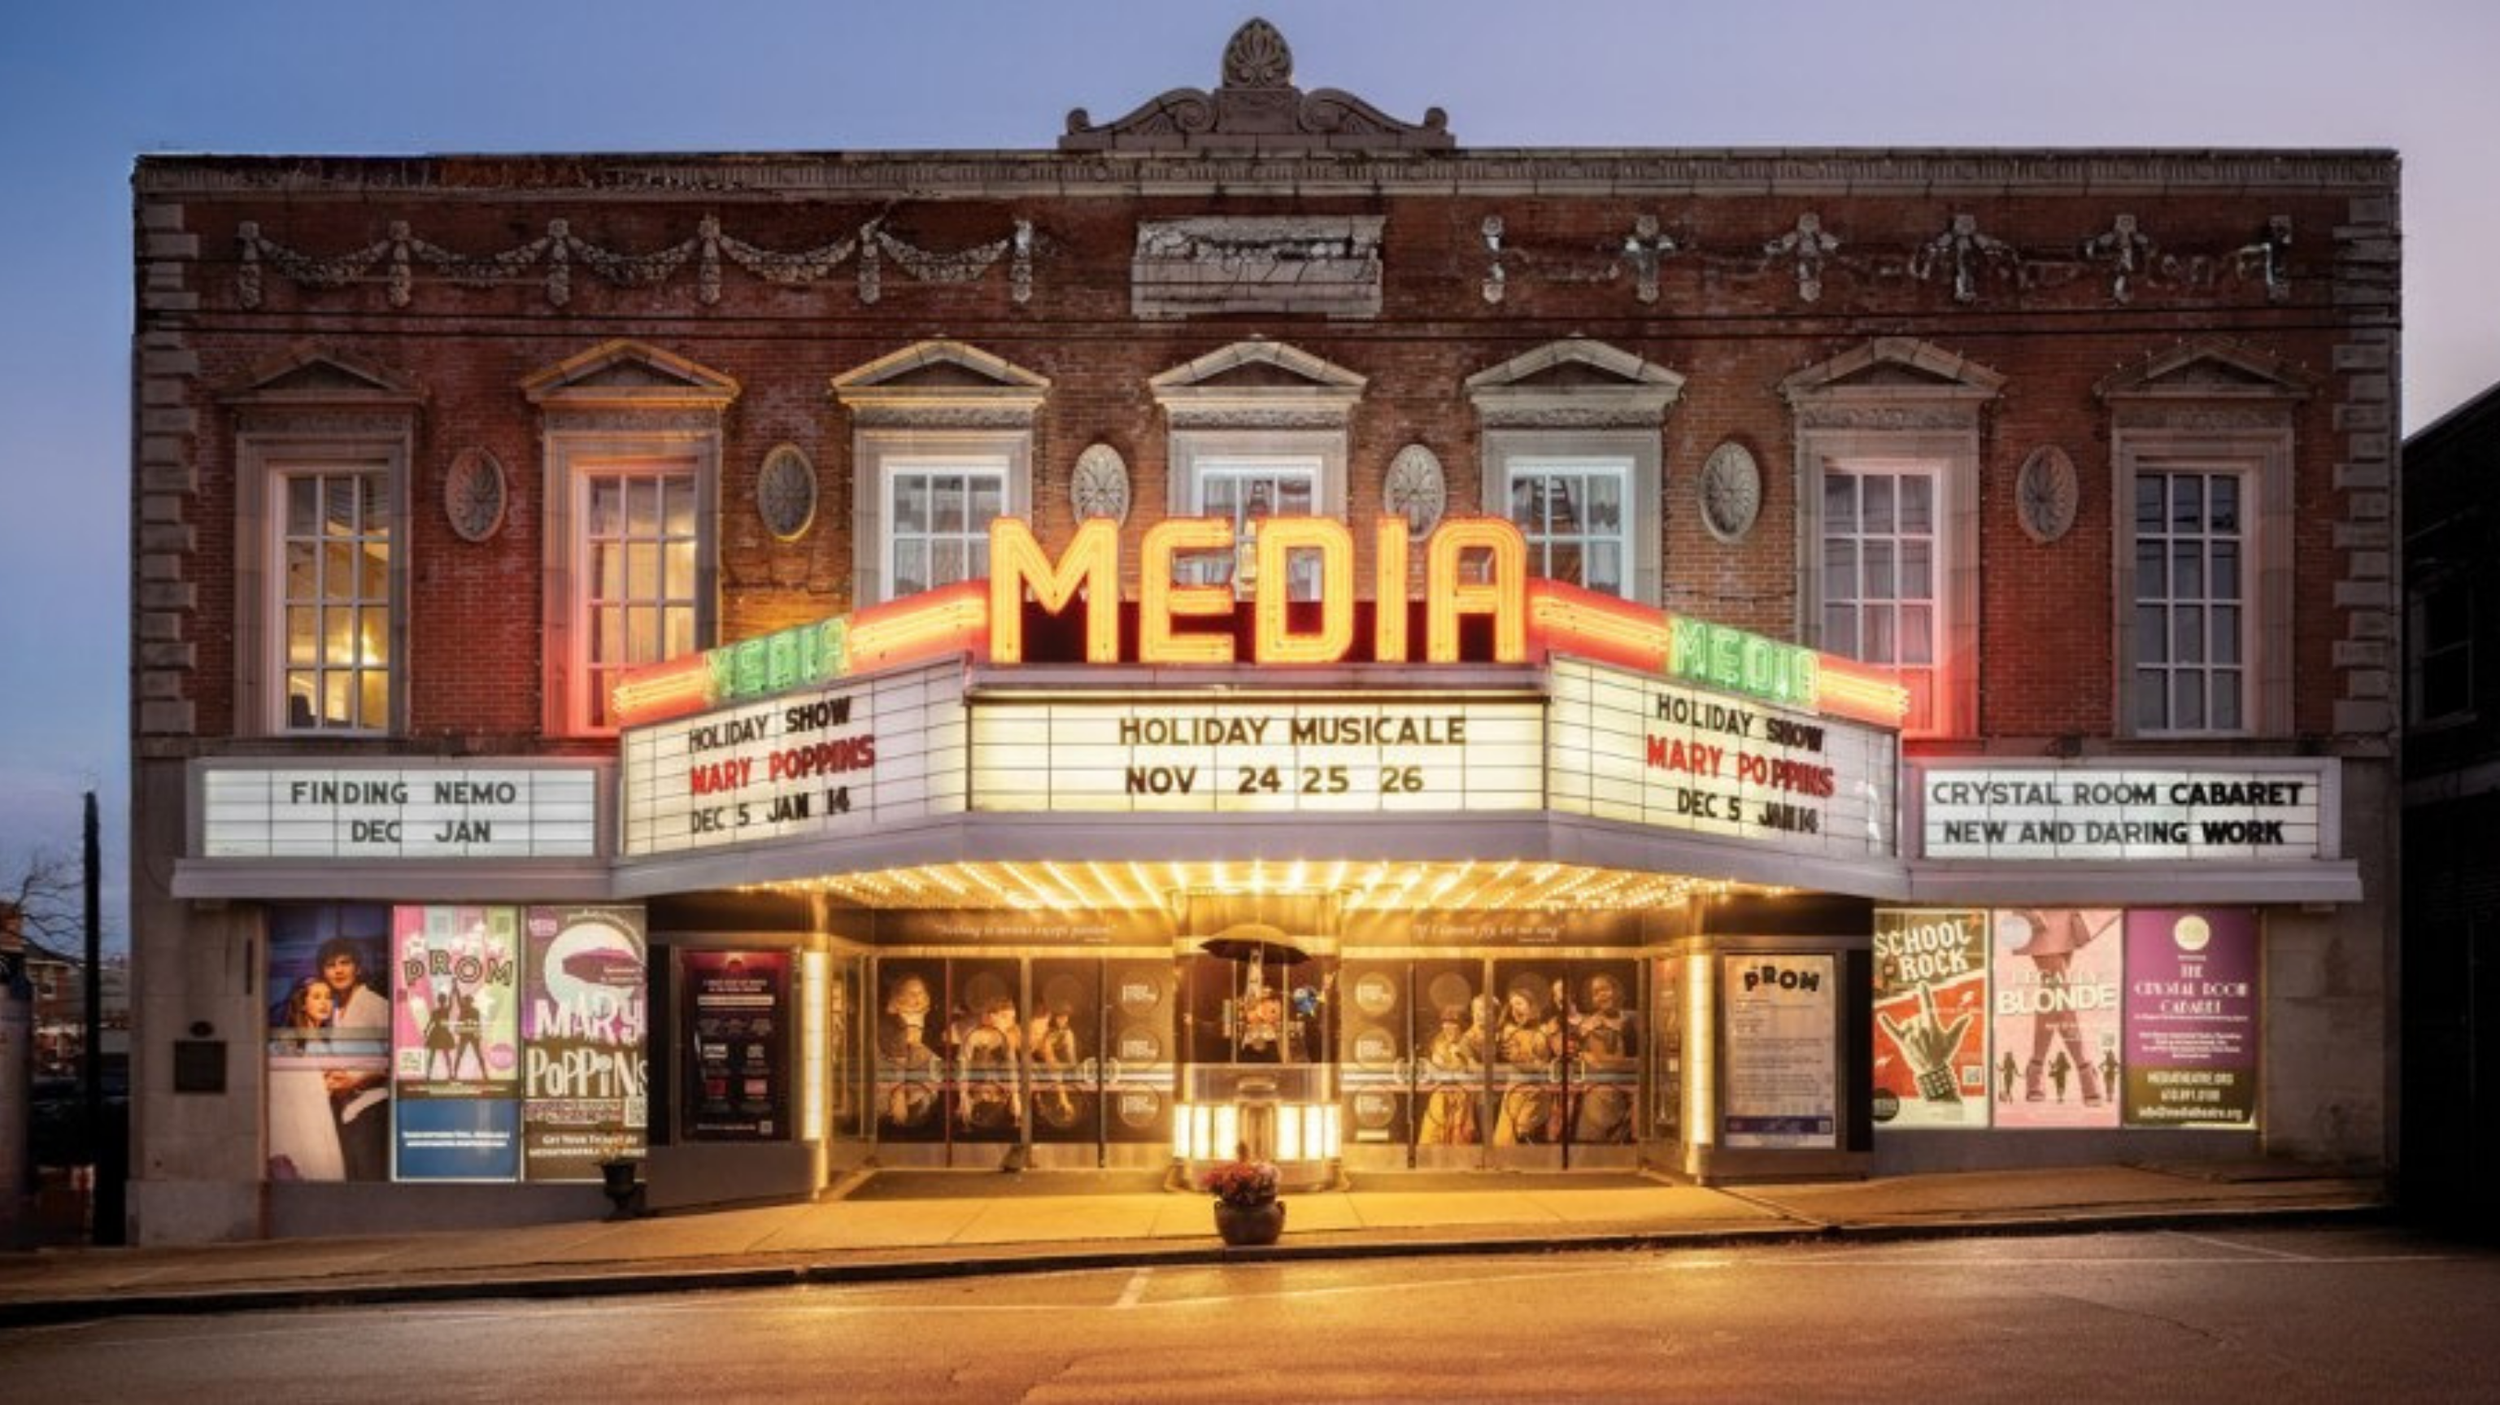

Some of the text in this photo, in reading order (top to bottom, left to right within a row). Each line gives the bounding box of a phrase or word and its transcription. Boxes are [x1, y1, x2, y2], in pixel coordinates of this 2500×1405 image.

[990, 517, 1527, 663] MEDIA
[689, 696, 851, 754] HOLIDAY SHOW
[1119, 716, 1467, 746] HOLIDAY MUSICALE
[1656, 692, 1824, 752] HOLIDAY SHOW
[690, 734, 876, 796] MARY POPPINS
[1126, 766, 1424, 794] NOV 24 25 26
[1647, 734, 1834, 798] MARY POPPINS
[291, 781, 516, 804] FINDING NEMO
[691, 786, 850, 834] DEC 5 JAN 14
[1932, 781, 2304, 807] CRYSTAL ROOM CABARET
[1678, 788, 1819, 834] DEC 5 JAN 14
[352, 820, 491, 843] DEC JAN
[1944, 820, 2284, 845] NEW AND DARING WORK
[1874, 919, 1972, 957] SCHOOL
[404, 950, 513, 986] PROM
[1744, 966, 1820, 992] PROM
[1899, 948, 1969, 981] ROCK
[533, 990, 643, 1046] MARY
[1998, 985, 2117, 1015] BLONDE
